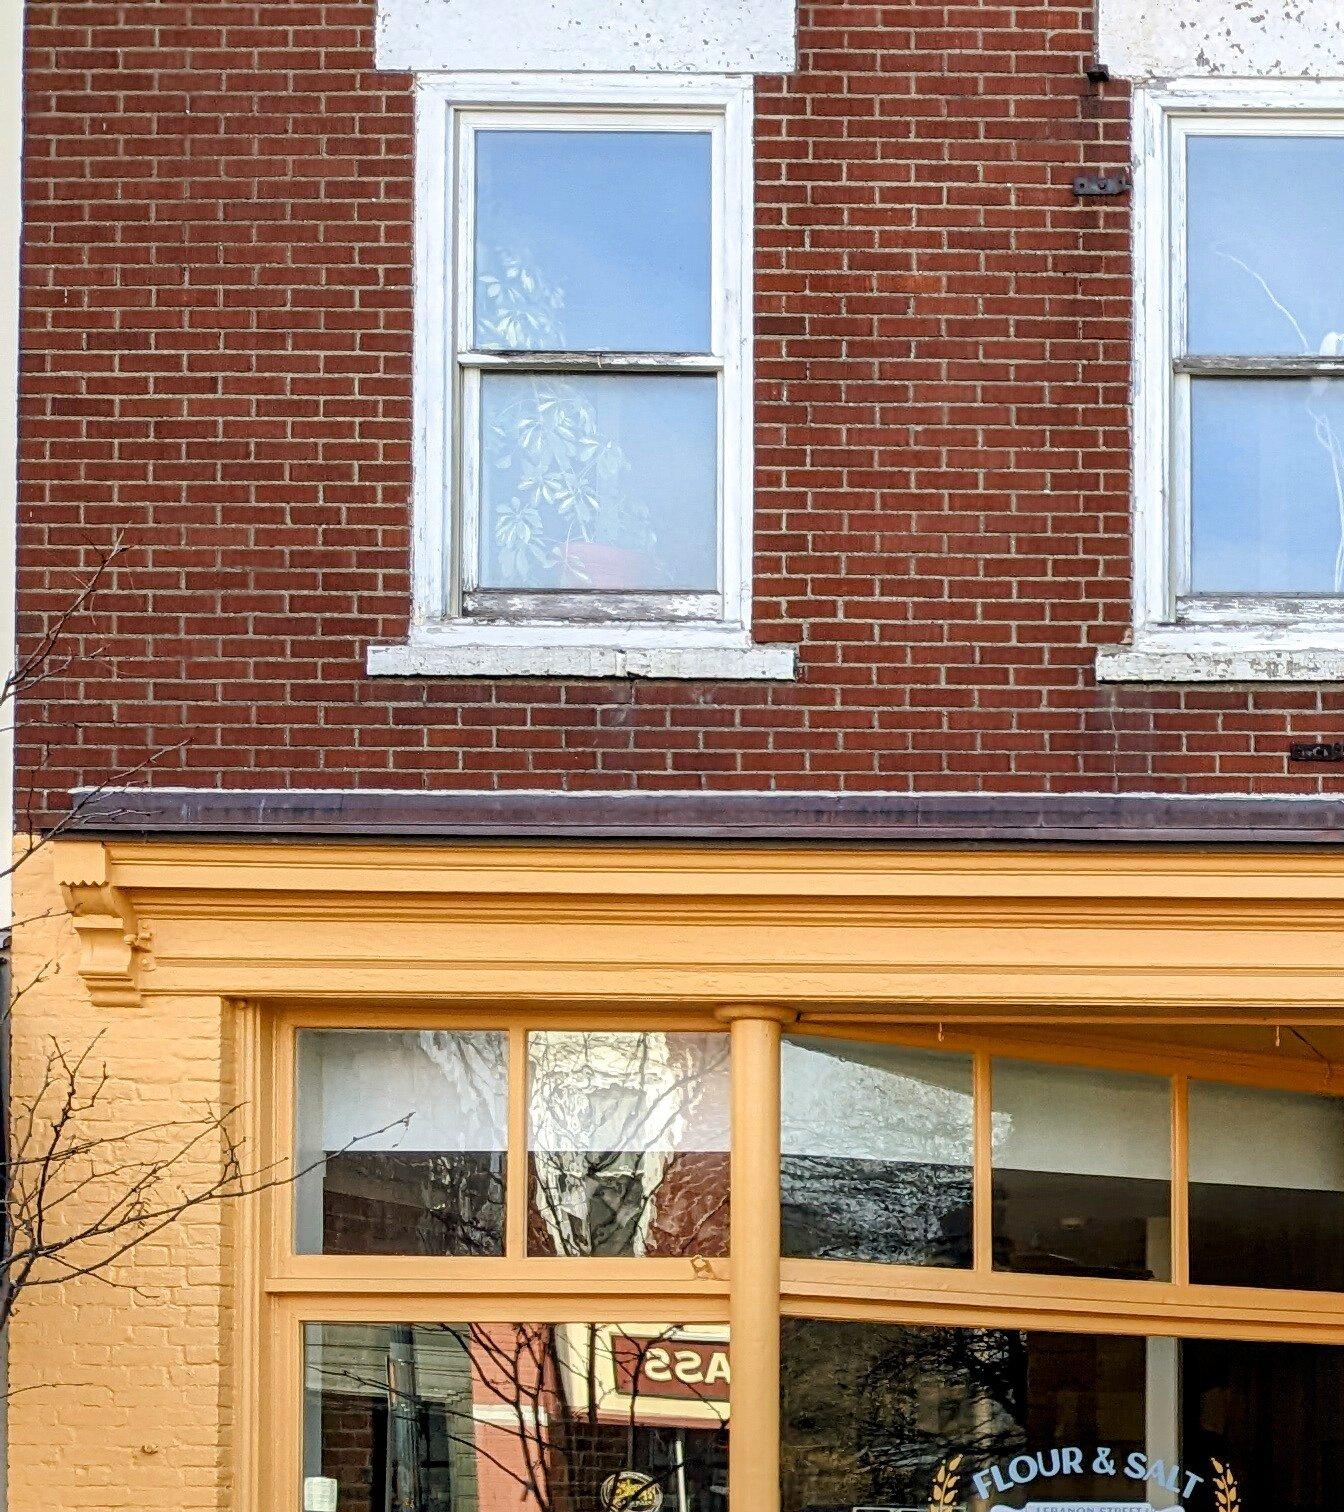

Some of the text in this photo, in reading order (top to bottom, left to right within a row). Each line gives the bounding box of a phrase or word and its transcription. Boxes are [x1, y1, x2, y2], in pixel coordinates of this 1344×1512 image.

[972, 1447, 1204, 1500] FLOUR & SALT
